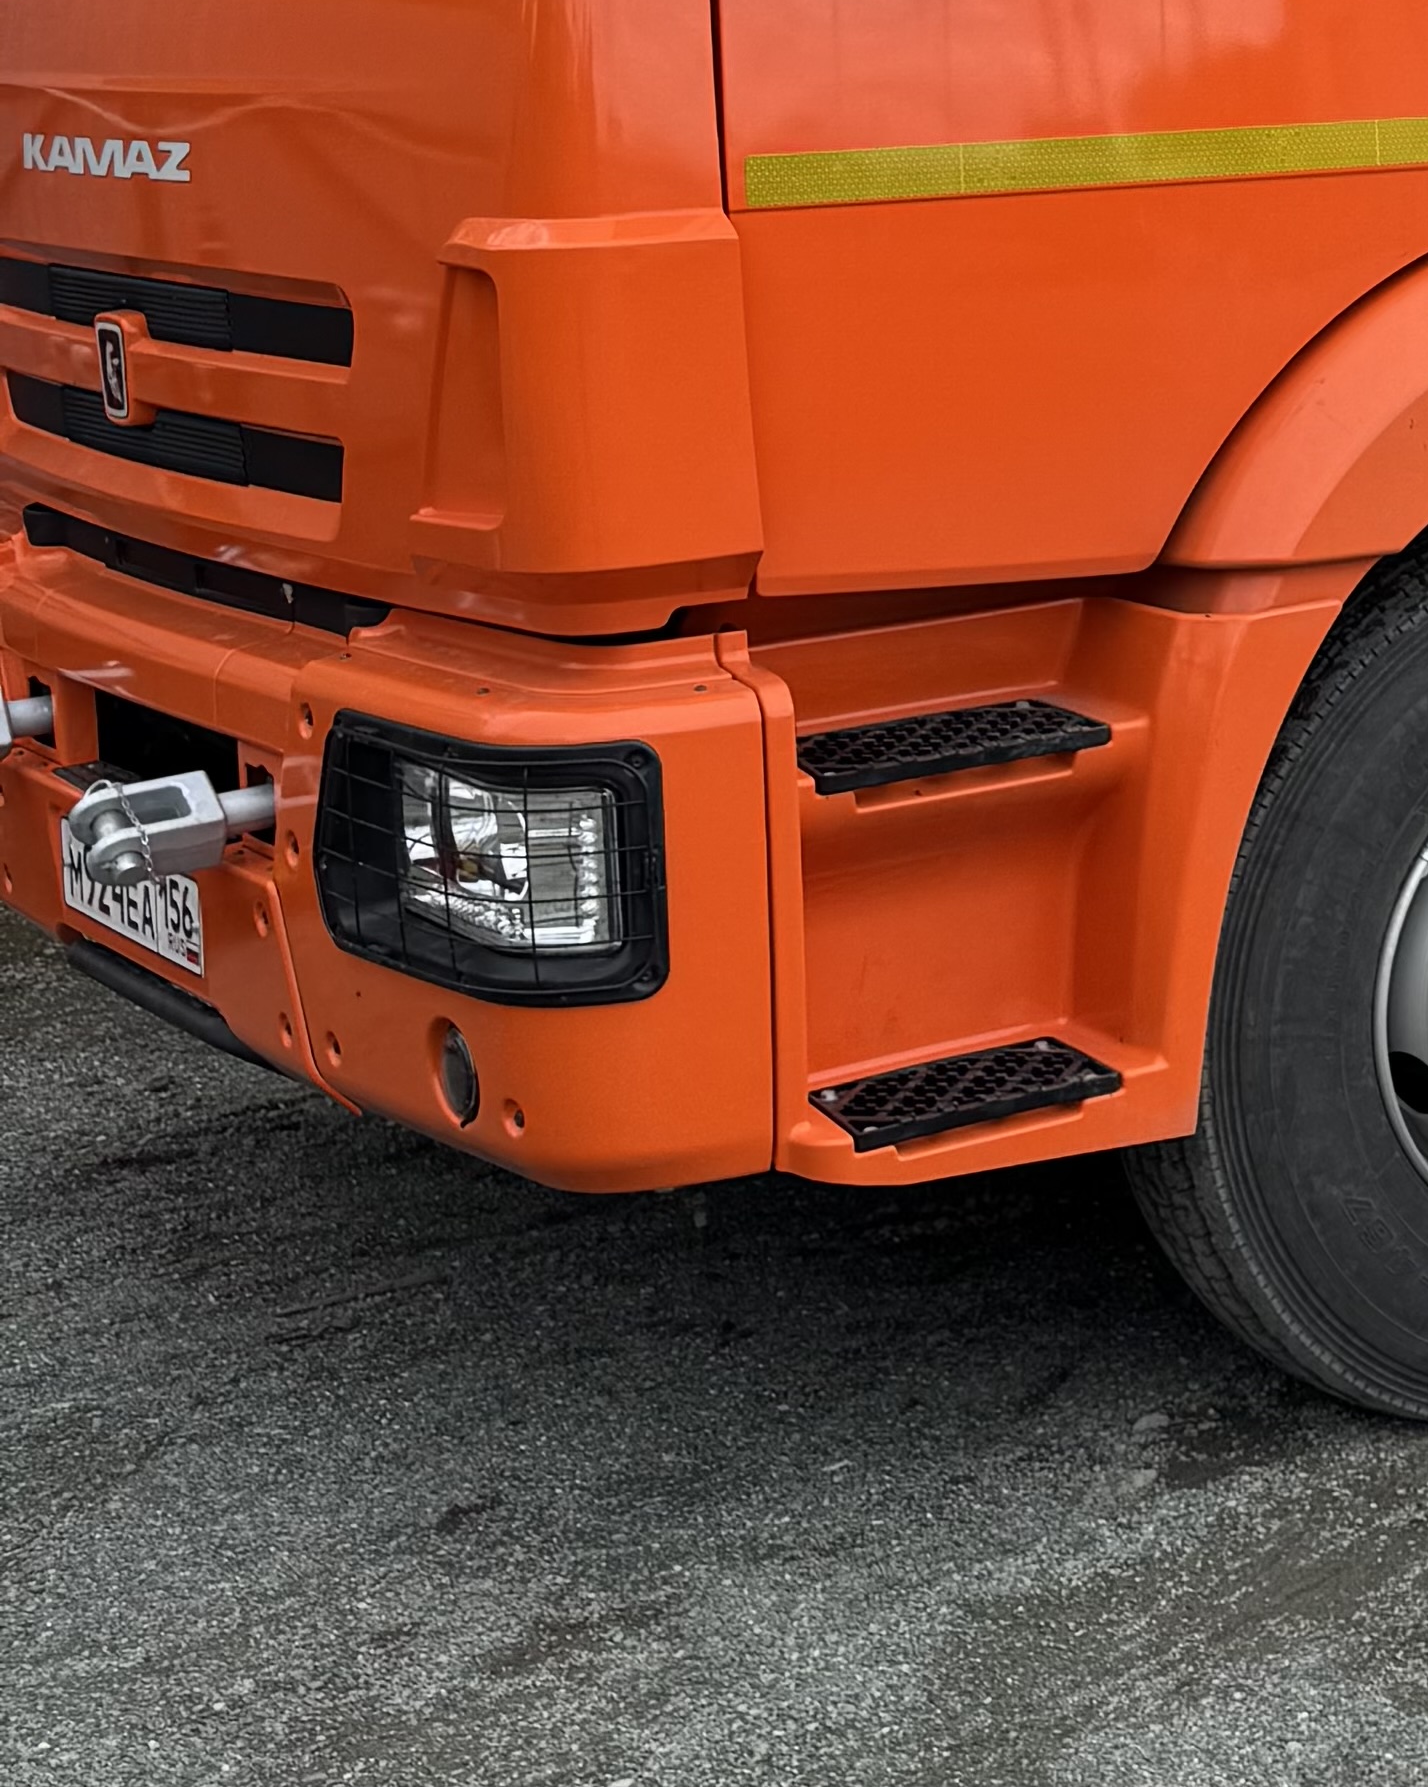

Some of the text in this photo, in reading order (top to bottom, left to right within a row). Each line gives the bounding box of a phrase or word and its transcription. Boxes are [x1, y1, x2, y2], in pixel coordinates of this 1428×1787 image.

[22, 132, 191, 183] KAMAZ
[159, 878, 194, 939] 156
[168, 931, 187, 958] RUS
